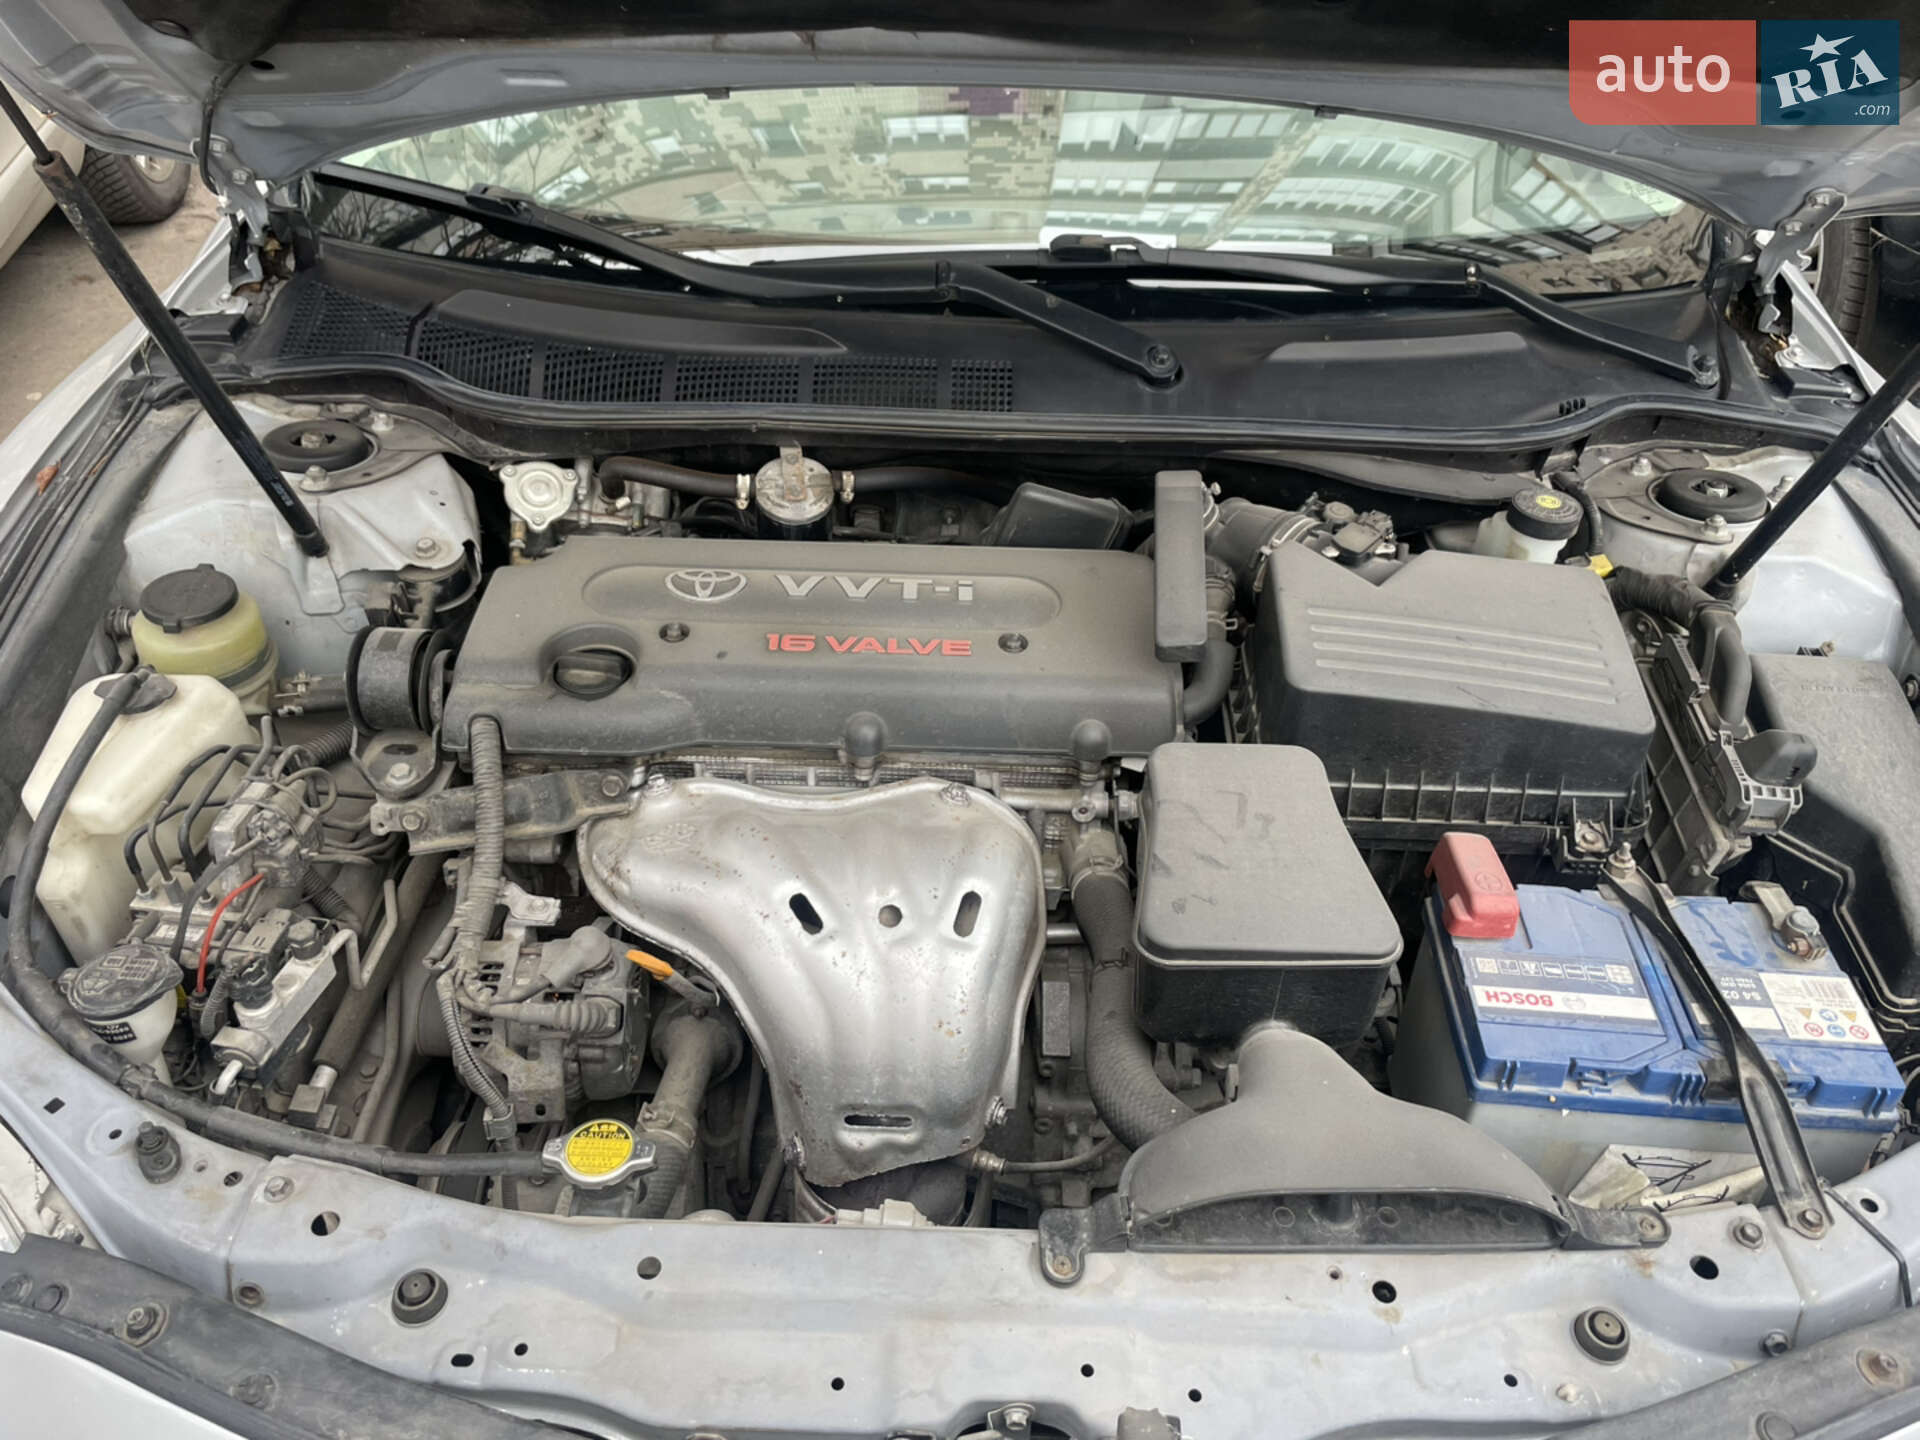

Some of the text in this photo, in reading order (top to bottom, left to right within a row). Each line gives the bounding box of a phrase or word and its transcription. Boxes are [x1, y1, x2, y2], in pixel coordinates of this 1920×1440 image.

[776, 574, 974, 602] VVT-i
[767, 633, 972, 657] 16 VALVE
[1485, 990, 1554, 1007] BOSCH
[579, 1131, 627, 1140] CAUTION
